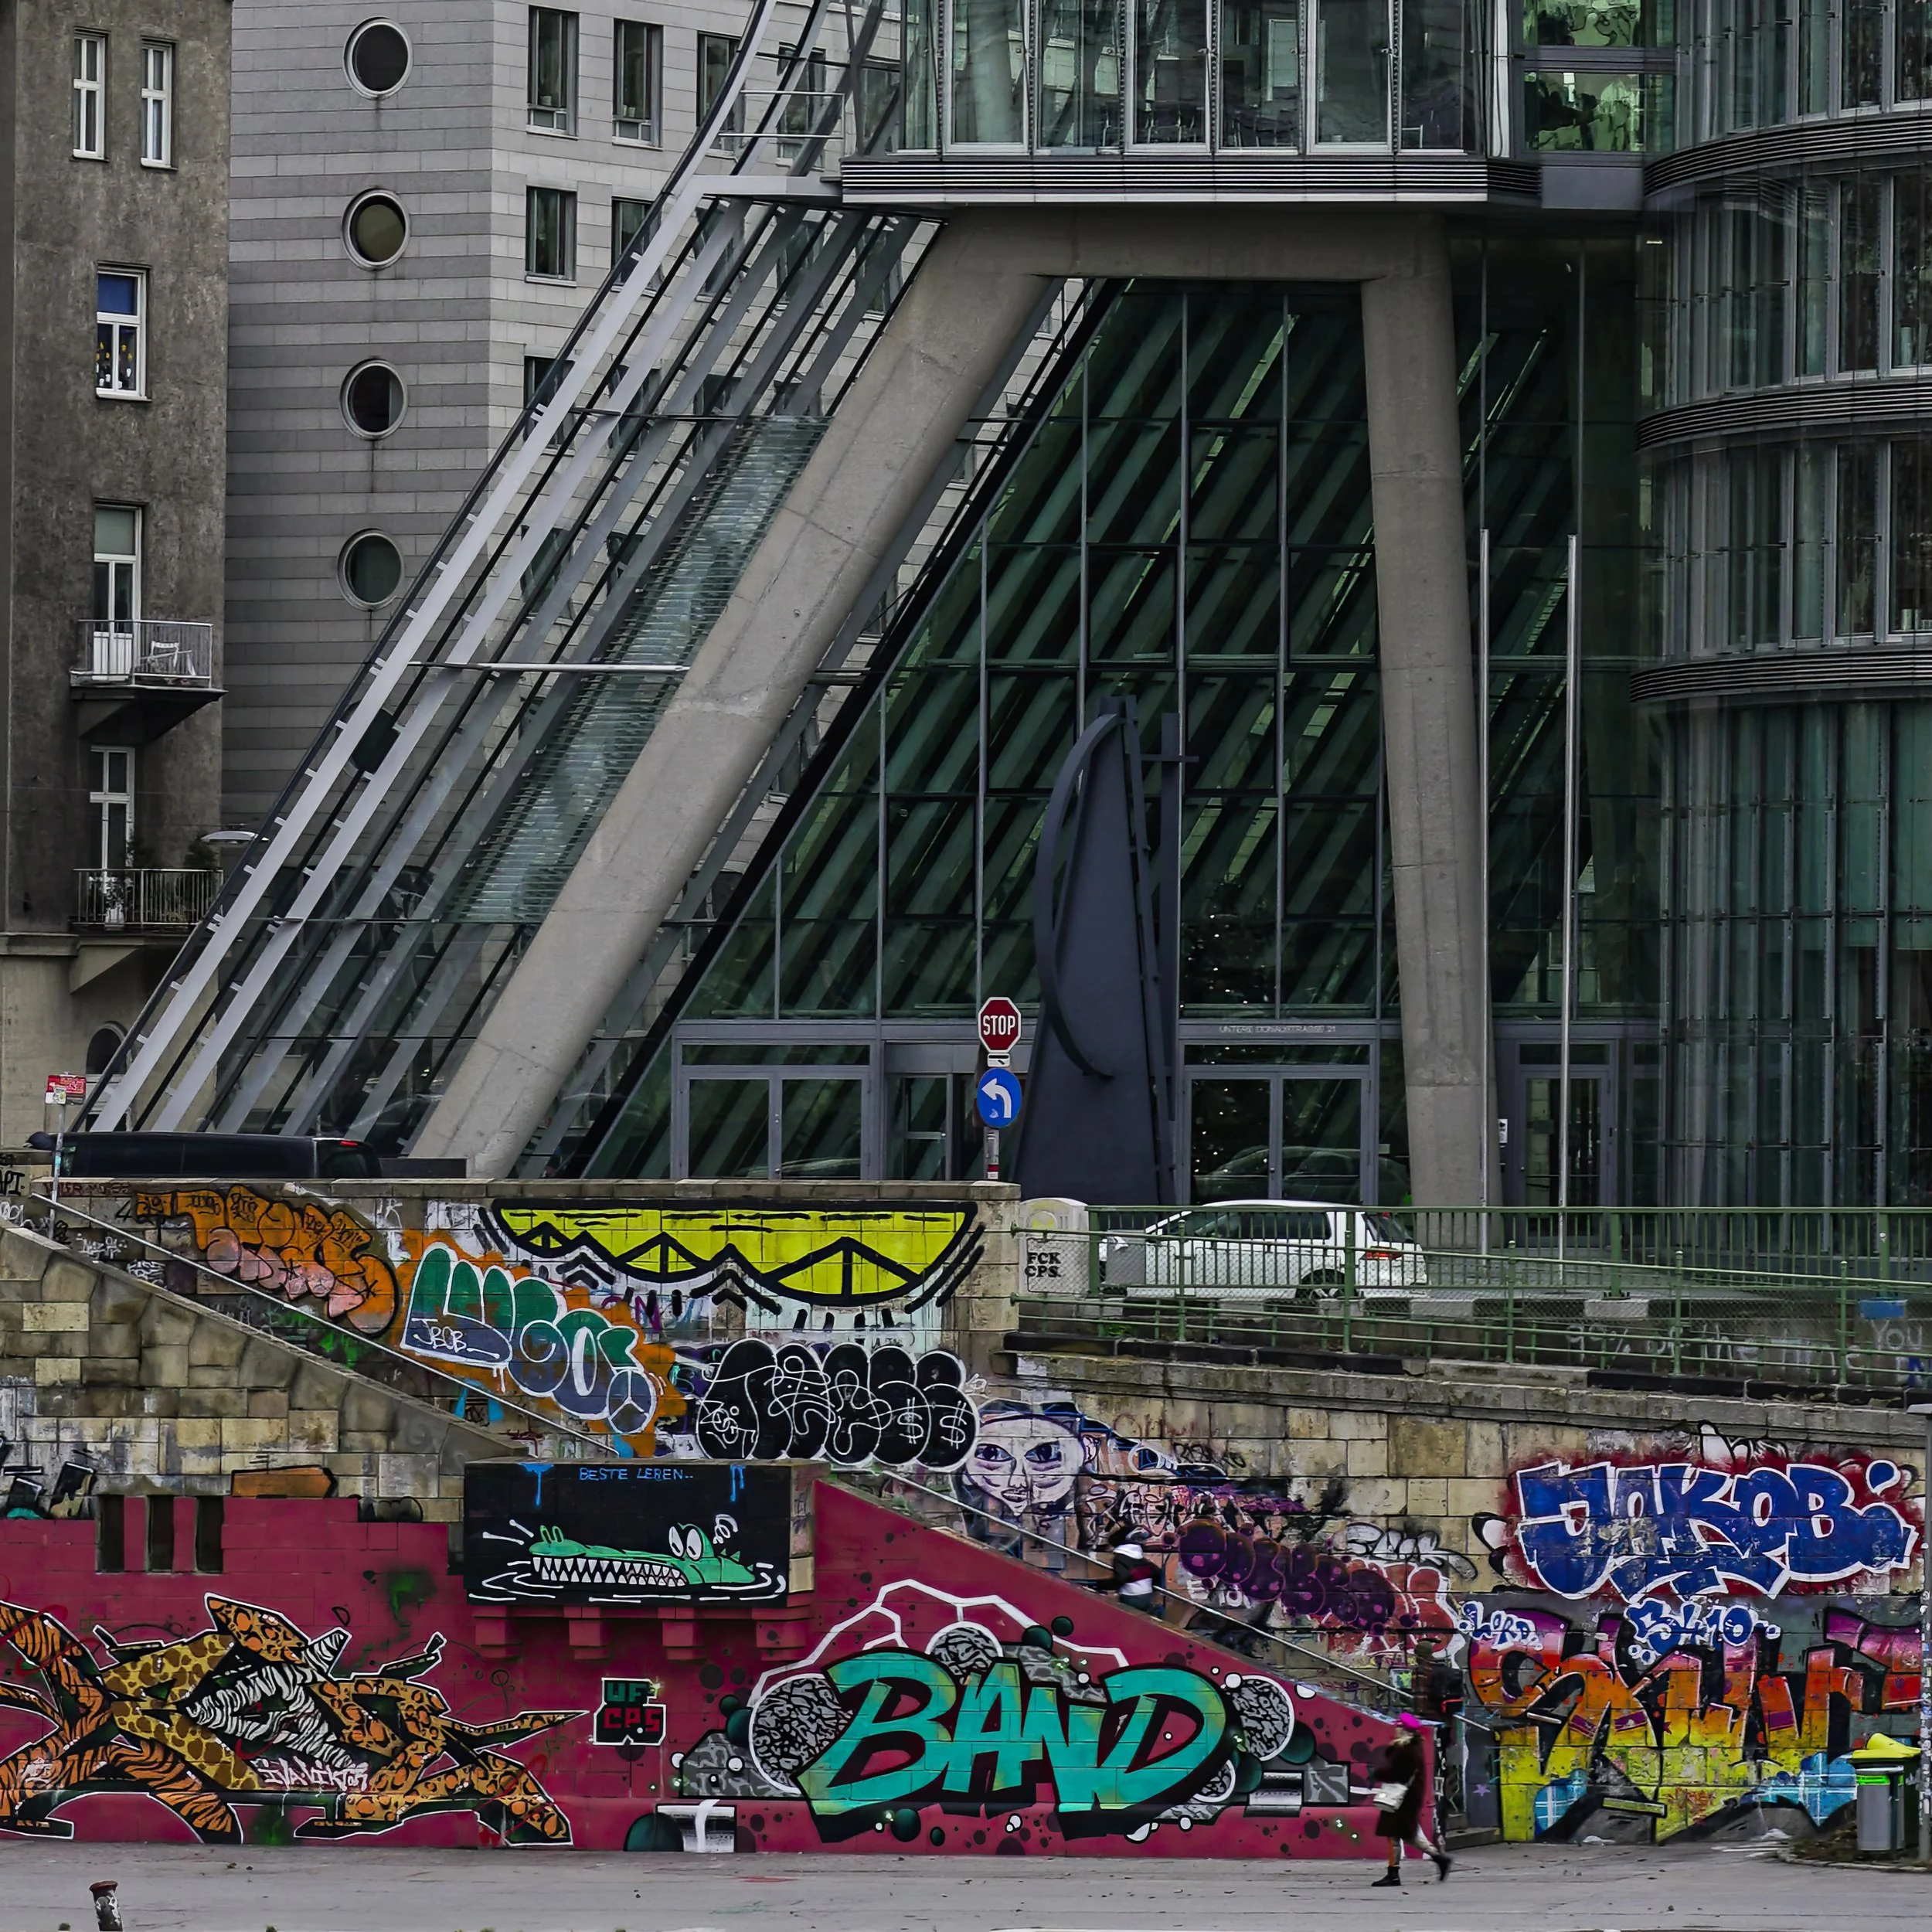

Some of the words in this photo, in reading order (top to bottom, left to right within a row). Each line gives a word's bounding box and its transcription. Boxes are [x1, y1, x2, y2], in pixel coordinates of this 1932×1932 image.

[982, 1015, 1015, 1036] STOP
[1026, 1252, 1062, 1265] FCK
[579, 1467, 628, 1481] BESTE
[797, 1651, 1228, 1816] BAND
